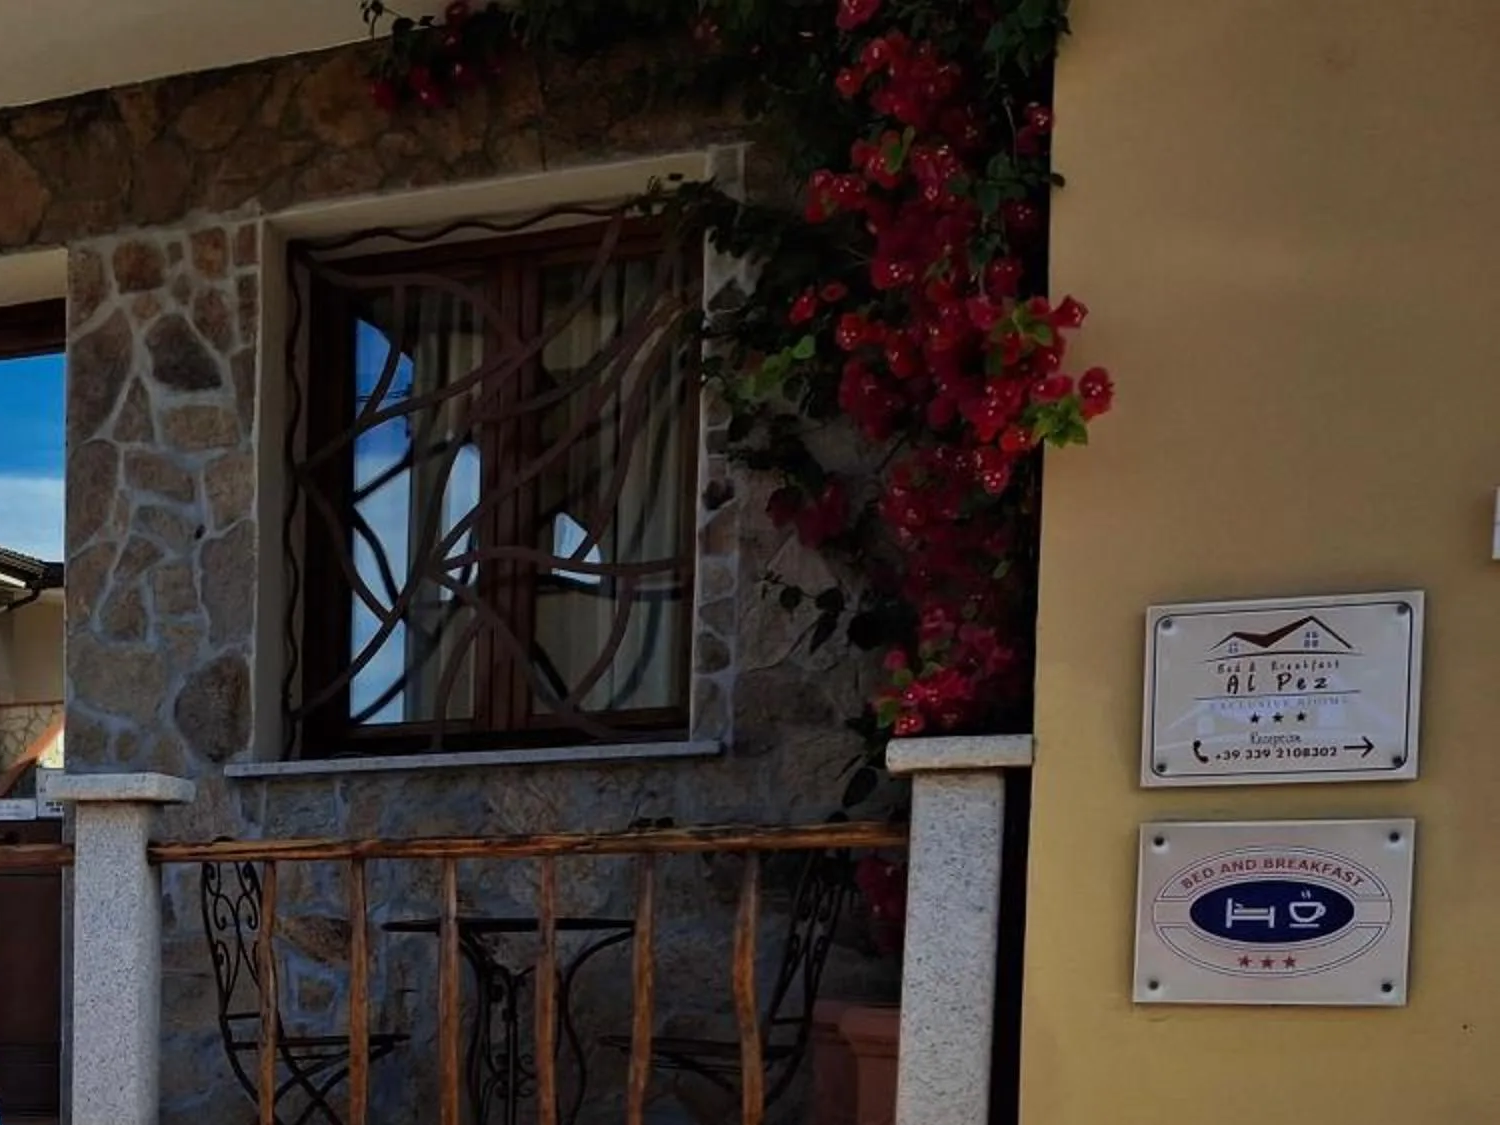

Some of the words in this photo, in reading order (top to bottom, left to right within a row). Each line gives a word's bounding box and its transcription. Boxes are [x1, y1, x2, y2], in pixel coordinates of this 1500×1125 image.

[1215, 749, 1241, 761] +39
[1245, 748, 1272, 761] 339
[1276, 746, 1338, 759] 2108302
[1180, 867, 1216, 890] BED
[1219, 859, 1258, 876] AND
[1263, 858, 1366, 889] BREAKFAST
